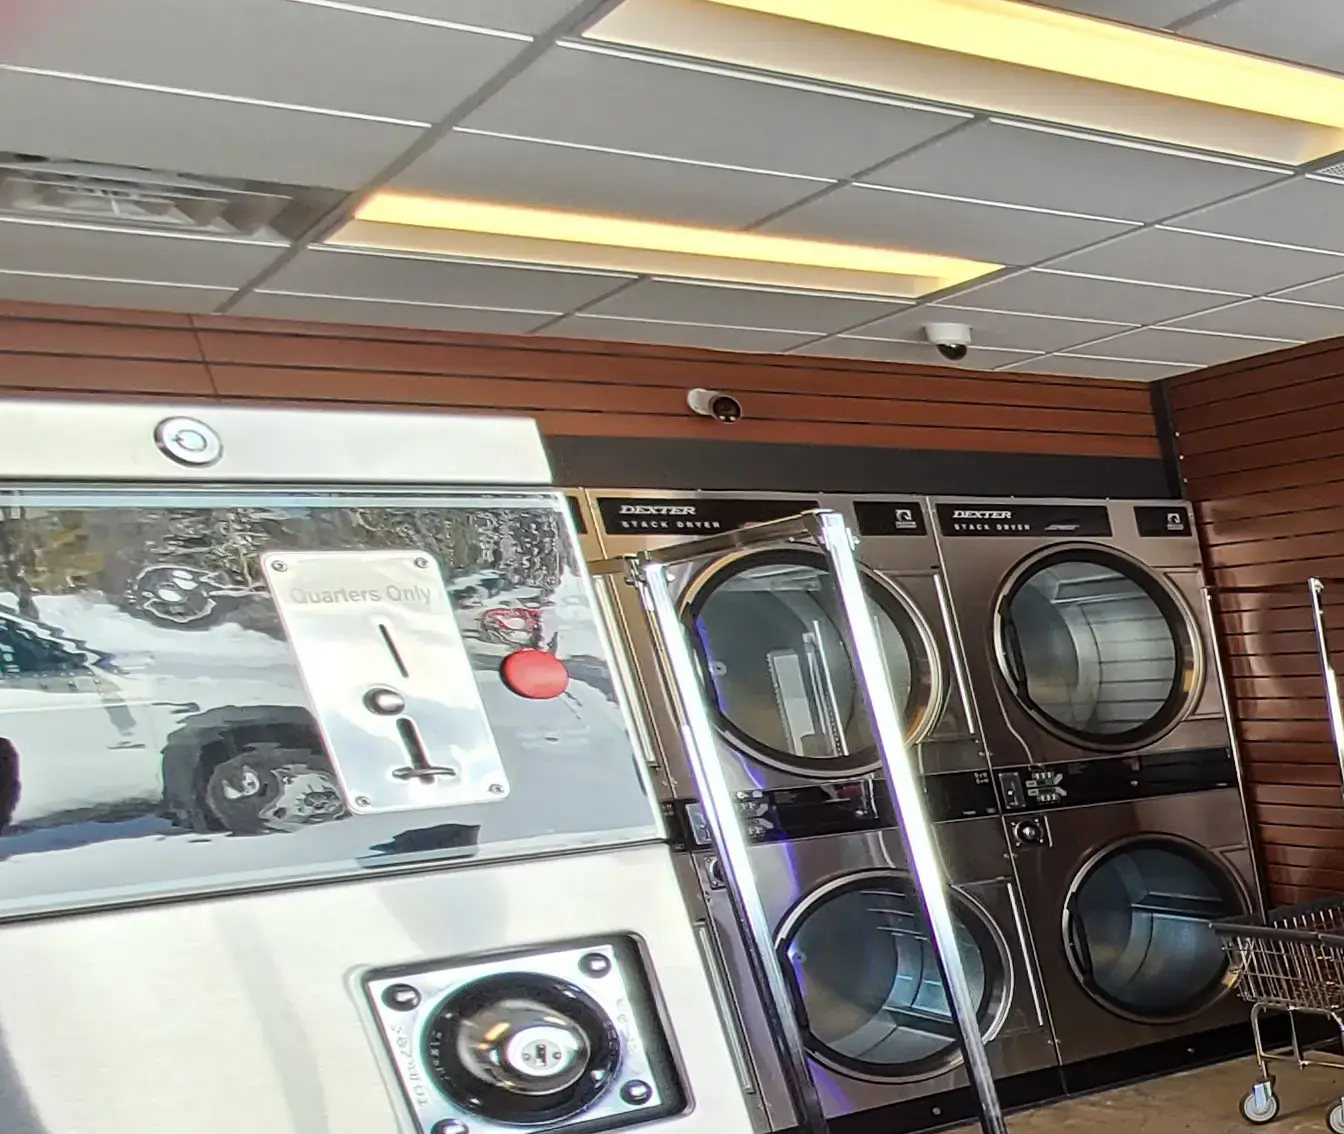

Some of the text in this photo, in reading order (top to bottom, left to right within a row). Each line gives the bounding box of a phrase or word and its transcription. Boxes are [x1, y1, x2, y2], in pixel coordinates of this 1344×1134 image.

[618, 504, 697, 516] DEXTER
[951, 510, 1013, 520] DEXTER
[620, 520, 722, 530] STACK DRYER
[953, 523, 1032, 532] STACK DRYER
[290, 583, 432, 606] Quarters Only
